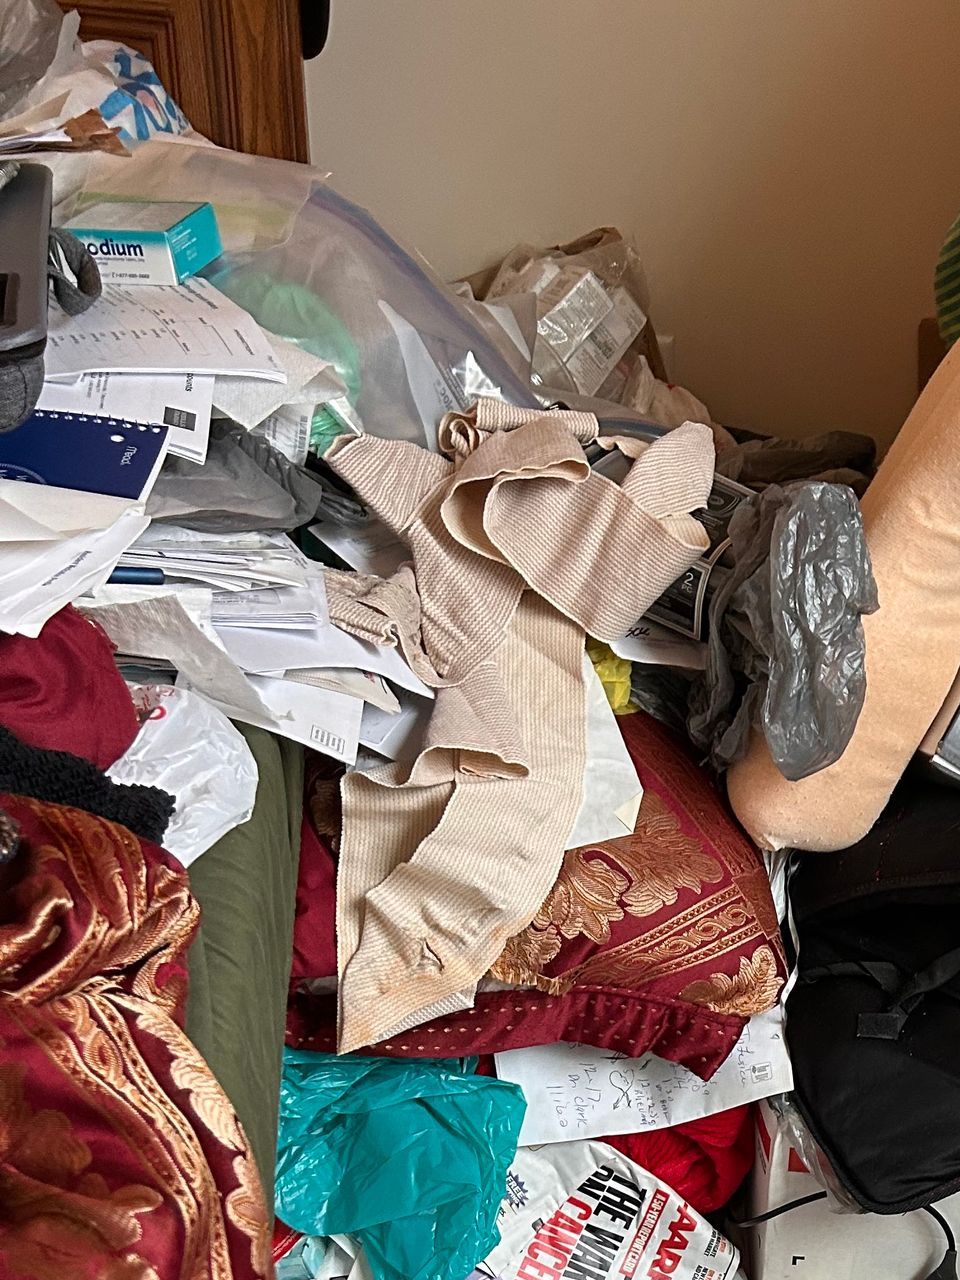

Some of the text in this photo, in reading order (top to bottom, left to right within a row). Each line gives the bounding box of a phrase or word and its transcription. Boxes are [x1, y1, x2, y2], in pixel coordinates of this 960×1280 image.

[682, 571, 695, 586] 2
[505, 1175, 525, 1200] FREE
[592, 1172, 648, 1231] THE
[642, 1197, 664, 1229] 50-YEAR
[630, 1225, 651, 1254] REPORT
[621, 1251, 639, 1273] CARD
